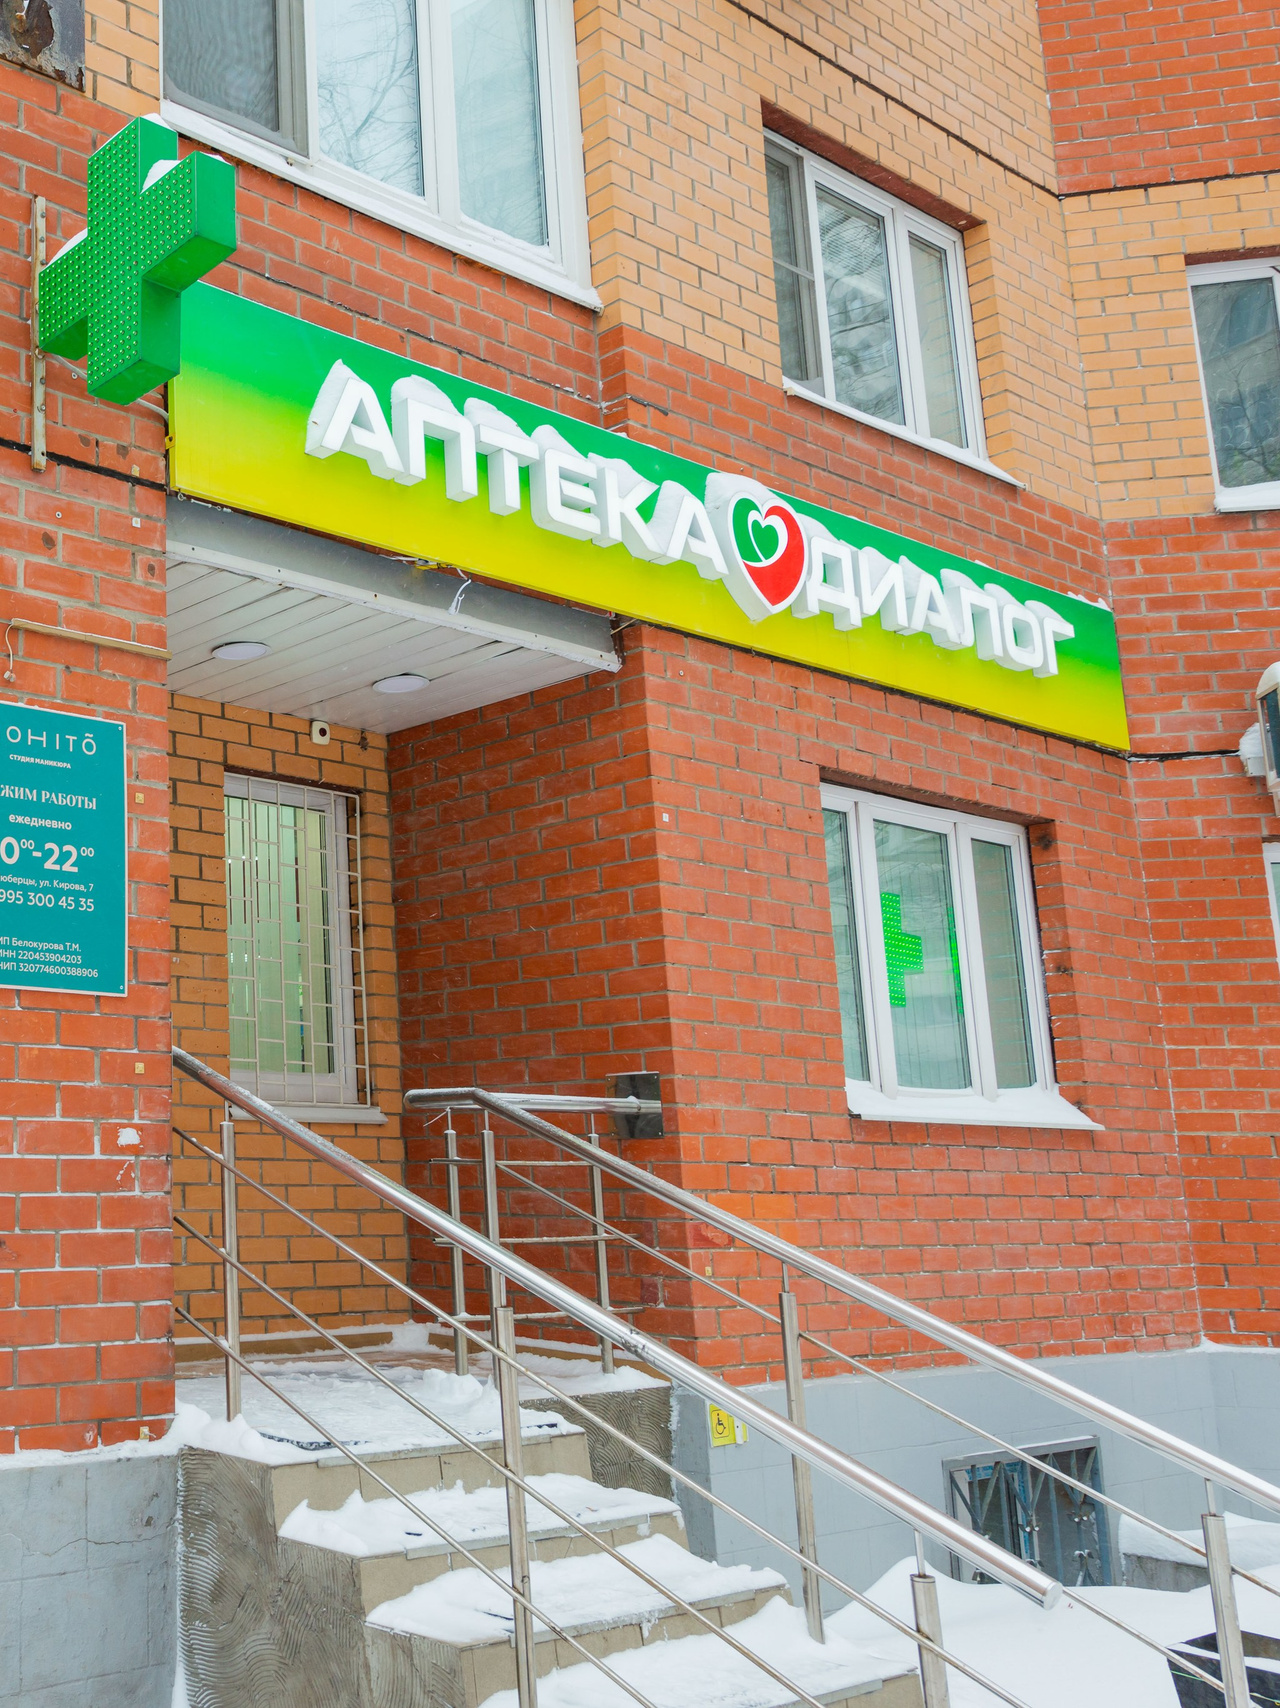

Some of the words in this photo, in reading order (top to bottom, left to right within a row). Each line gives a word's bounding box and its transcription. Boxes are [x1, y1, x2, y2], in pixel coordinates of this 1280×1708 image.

[305, 368, 730, 581] АПТЕКА
[791, 525, 1075, 679] ДИАЛОГ
[9, 754, 35, 764] СТУДИЯ
[35, 758, 72, 769] МАНИКЮРА
[41, 790, 97, 810] РАБОТЫ
[8, 814, 72, 831] ежедневно
[39, 881, 52, 889] ул.
[53, 880, 87, 892] Кирова,
[88, 884, 94, 892] 7
[27, 892, 55, 908] 300
[58, 896, 76, 910] 45
[78, 898, 95, 912] 35
[12, 937, 64, 951] Белокурова
[65, 942, 82, 952] Т.М.
[18, 950, 82, 965] 220453904203
[18, 962, 99, 978] 320774600388906
